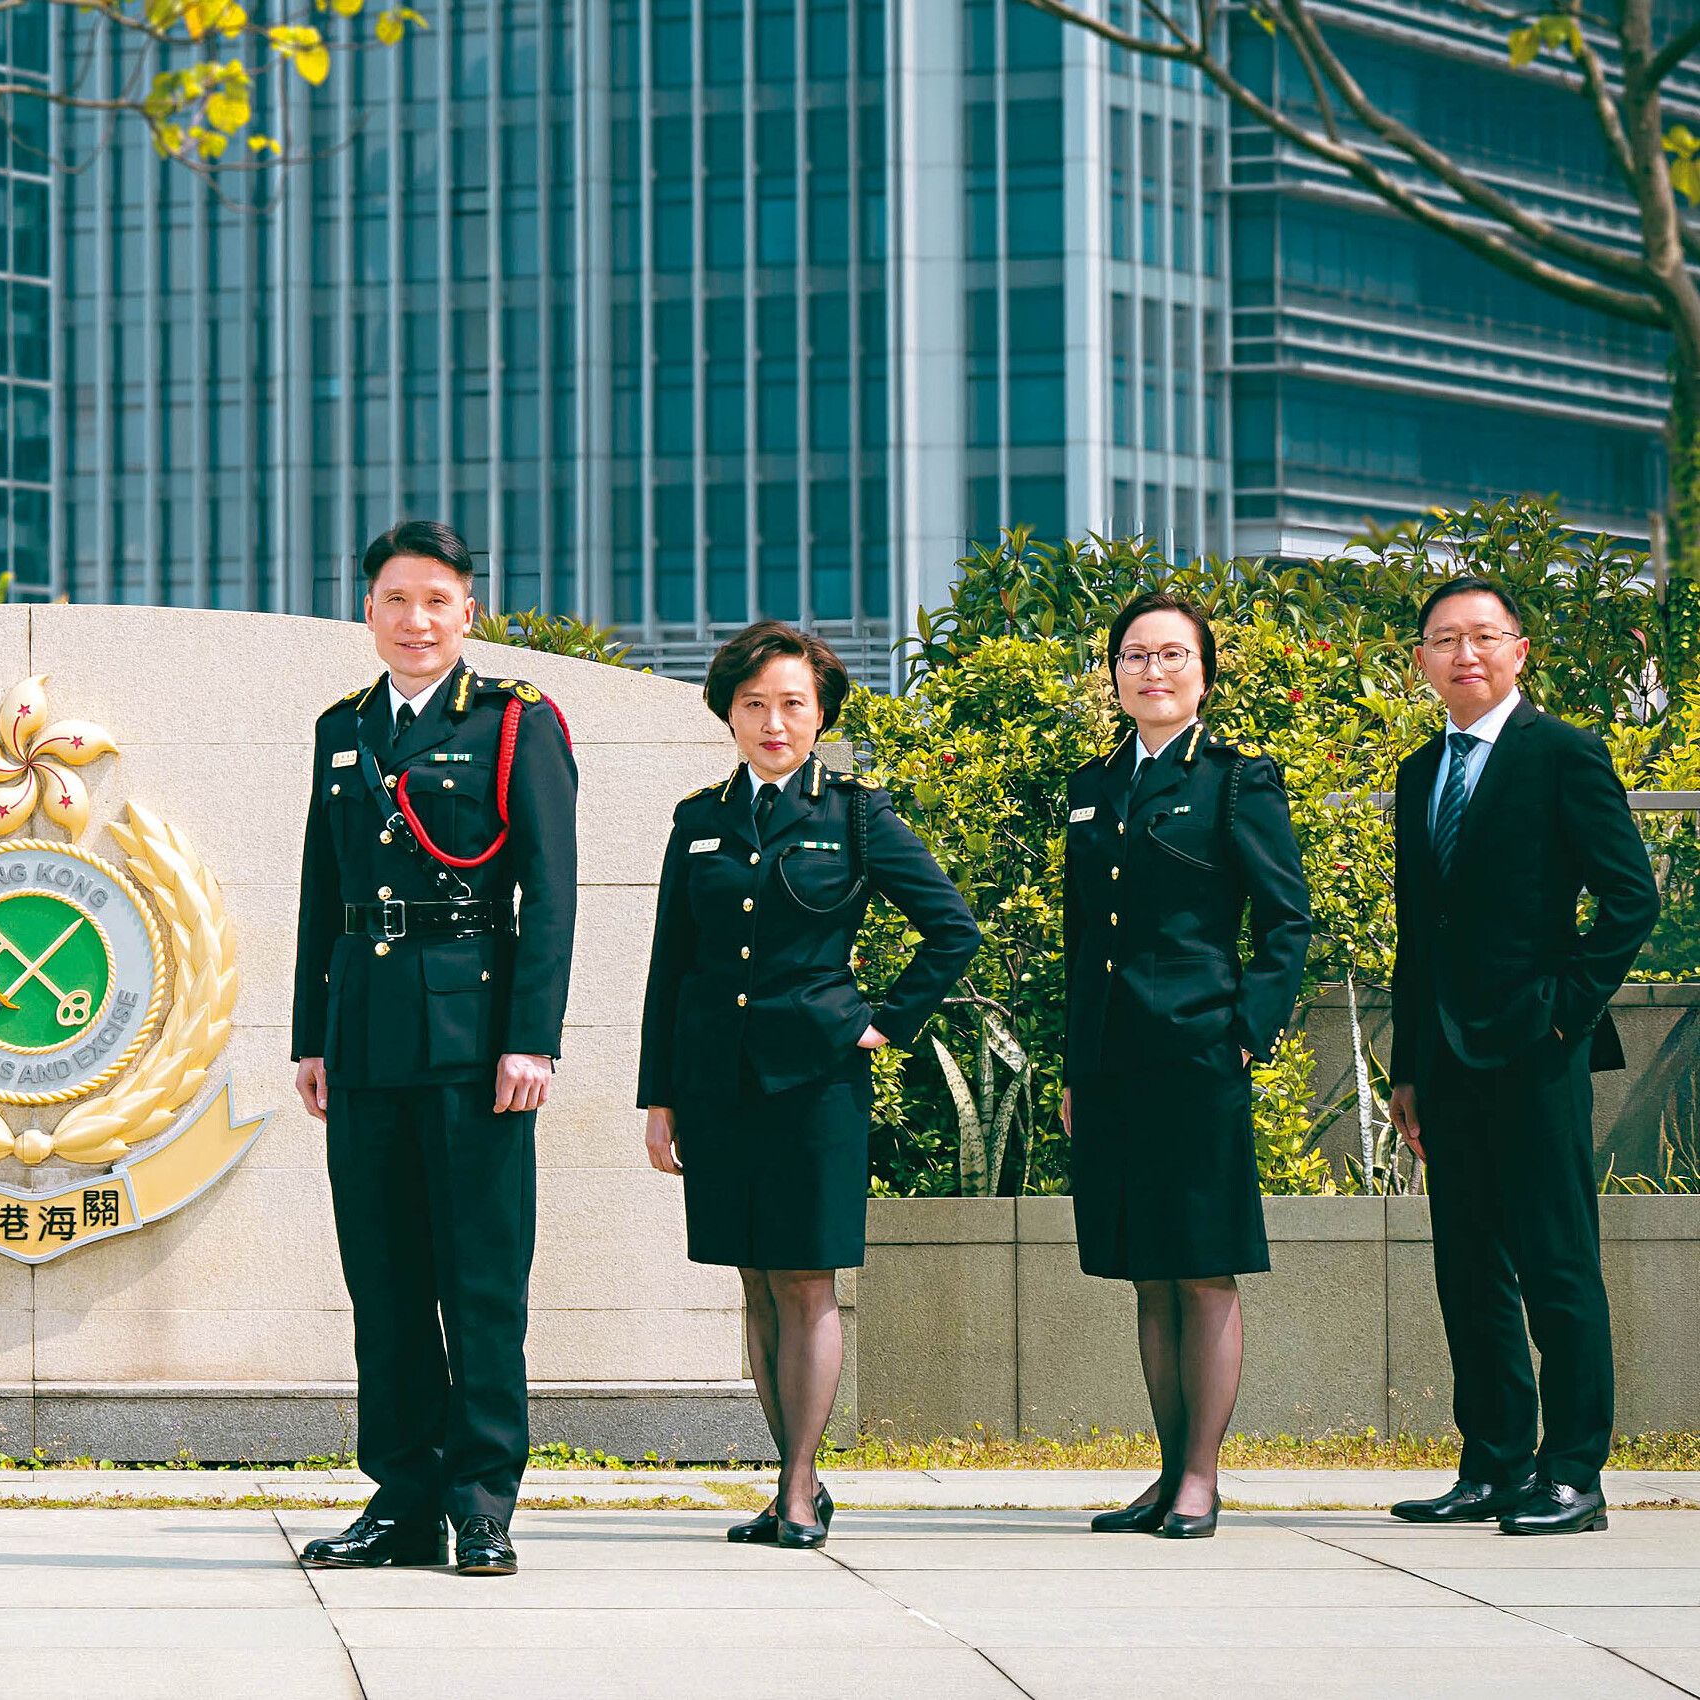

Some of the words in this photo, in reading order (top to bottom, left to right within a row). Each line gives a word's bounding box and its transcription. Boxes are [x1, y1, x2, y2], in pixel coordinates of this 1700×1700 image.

[35, 862, 109, 908] KONG
[17, 1057, 72, 1084] AND
[71, 988, 139, 1070] EXCISE
